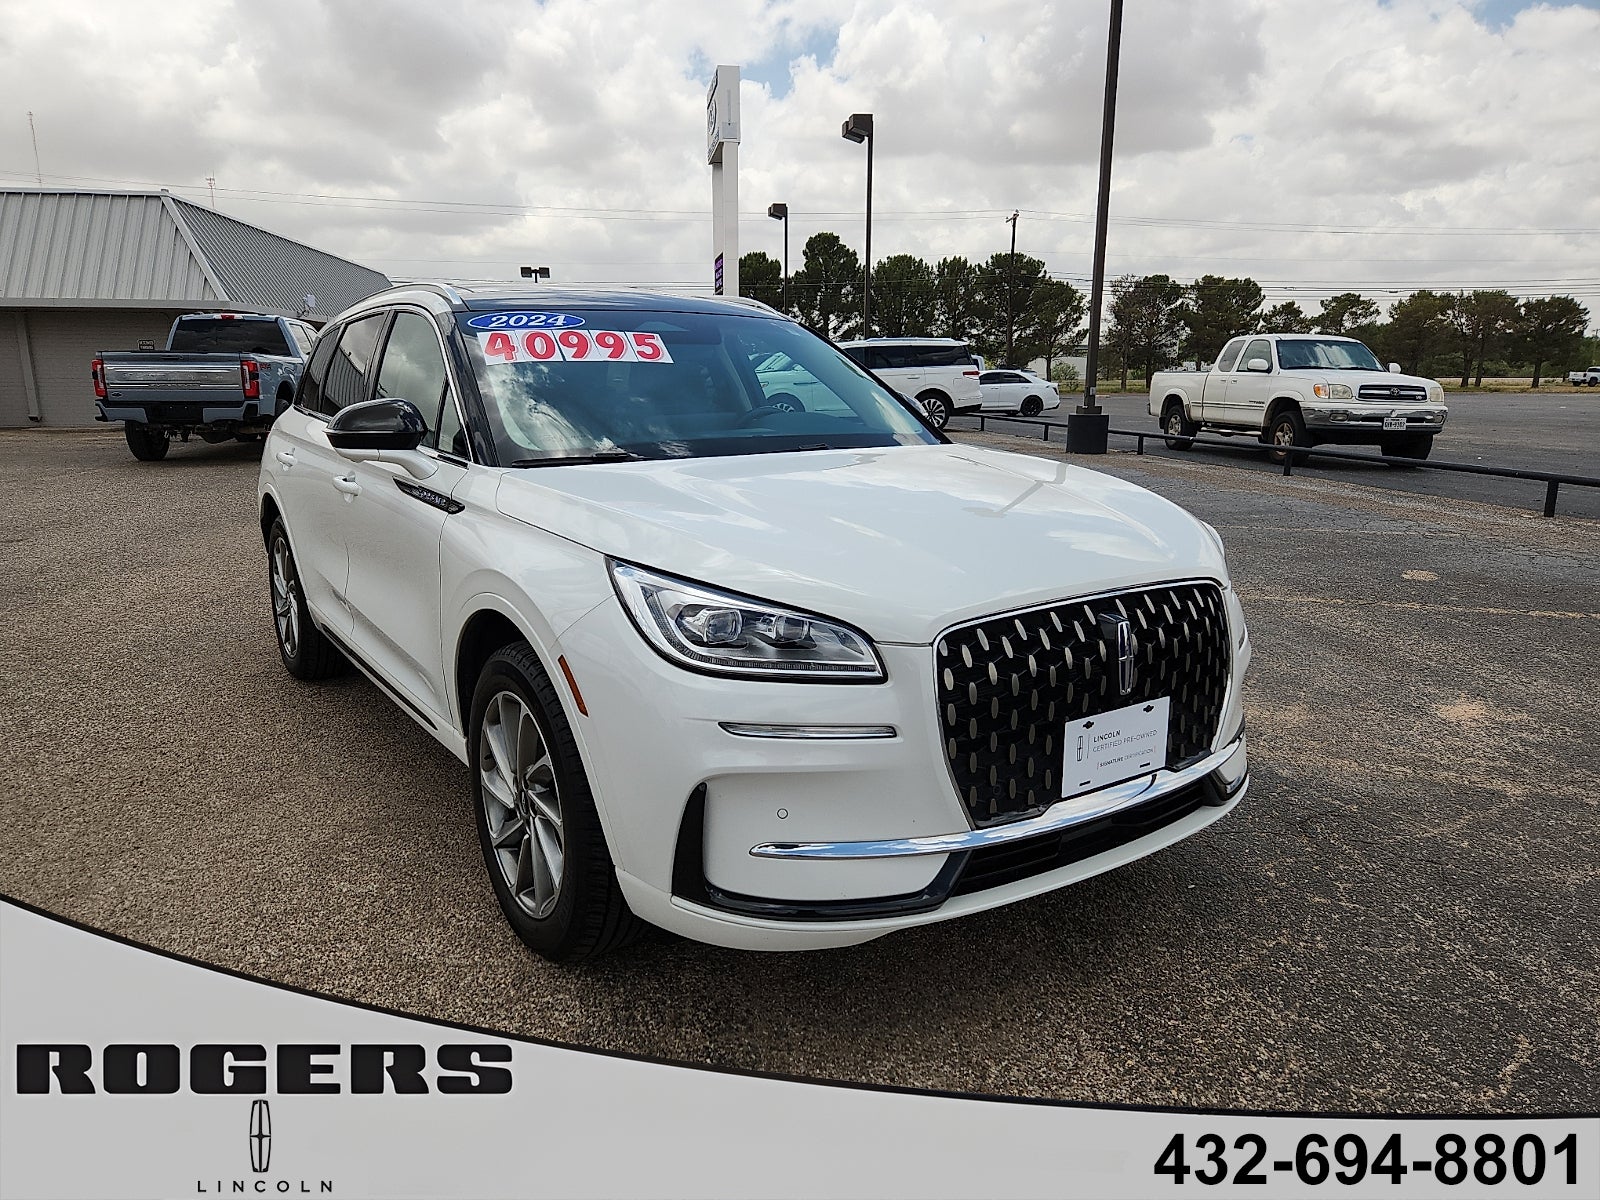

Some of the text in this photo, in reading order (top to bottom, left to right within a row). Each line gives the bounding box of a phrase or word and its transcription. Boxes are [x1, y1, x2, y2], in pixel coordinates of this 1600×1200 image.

[488, 314, 567, 328] 2024
[484, 330, 664, 361] 40995
[1093, 729, 1120, 742] LINCOLN
[1093, 730, 1157, 752] CERTIFIED PRE-OWNED
